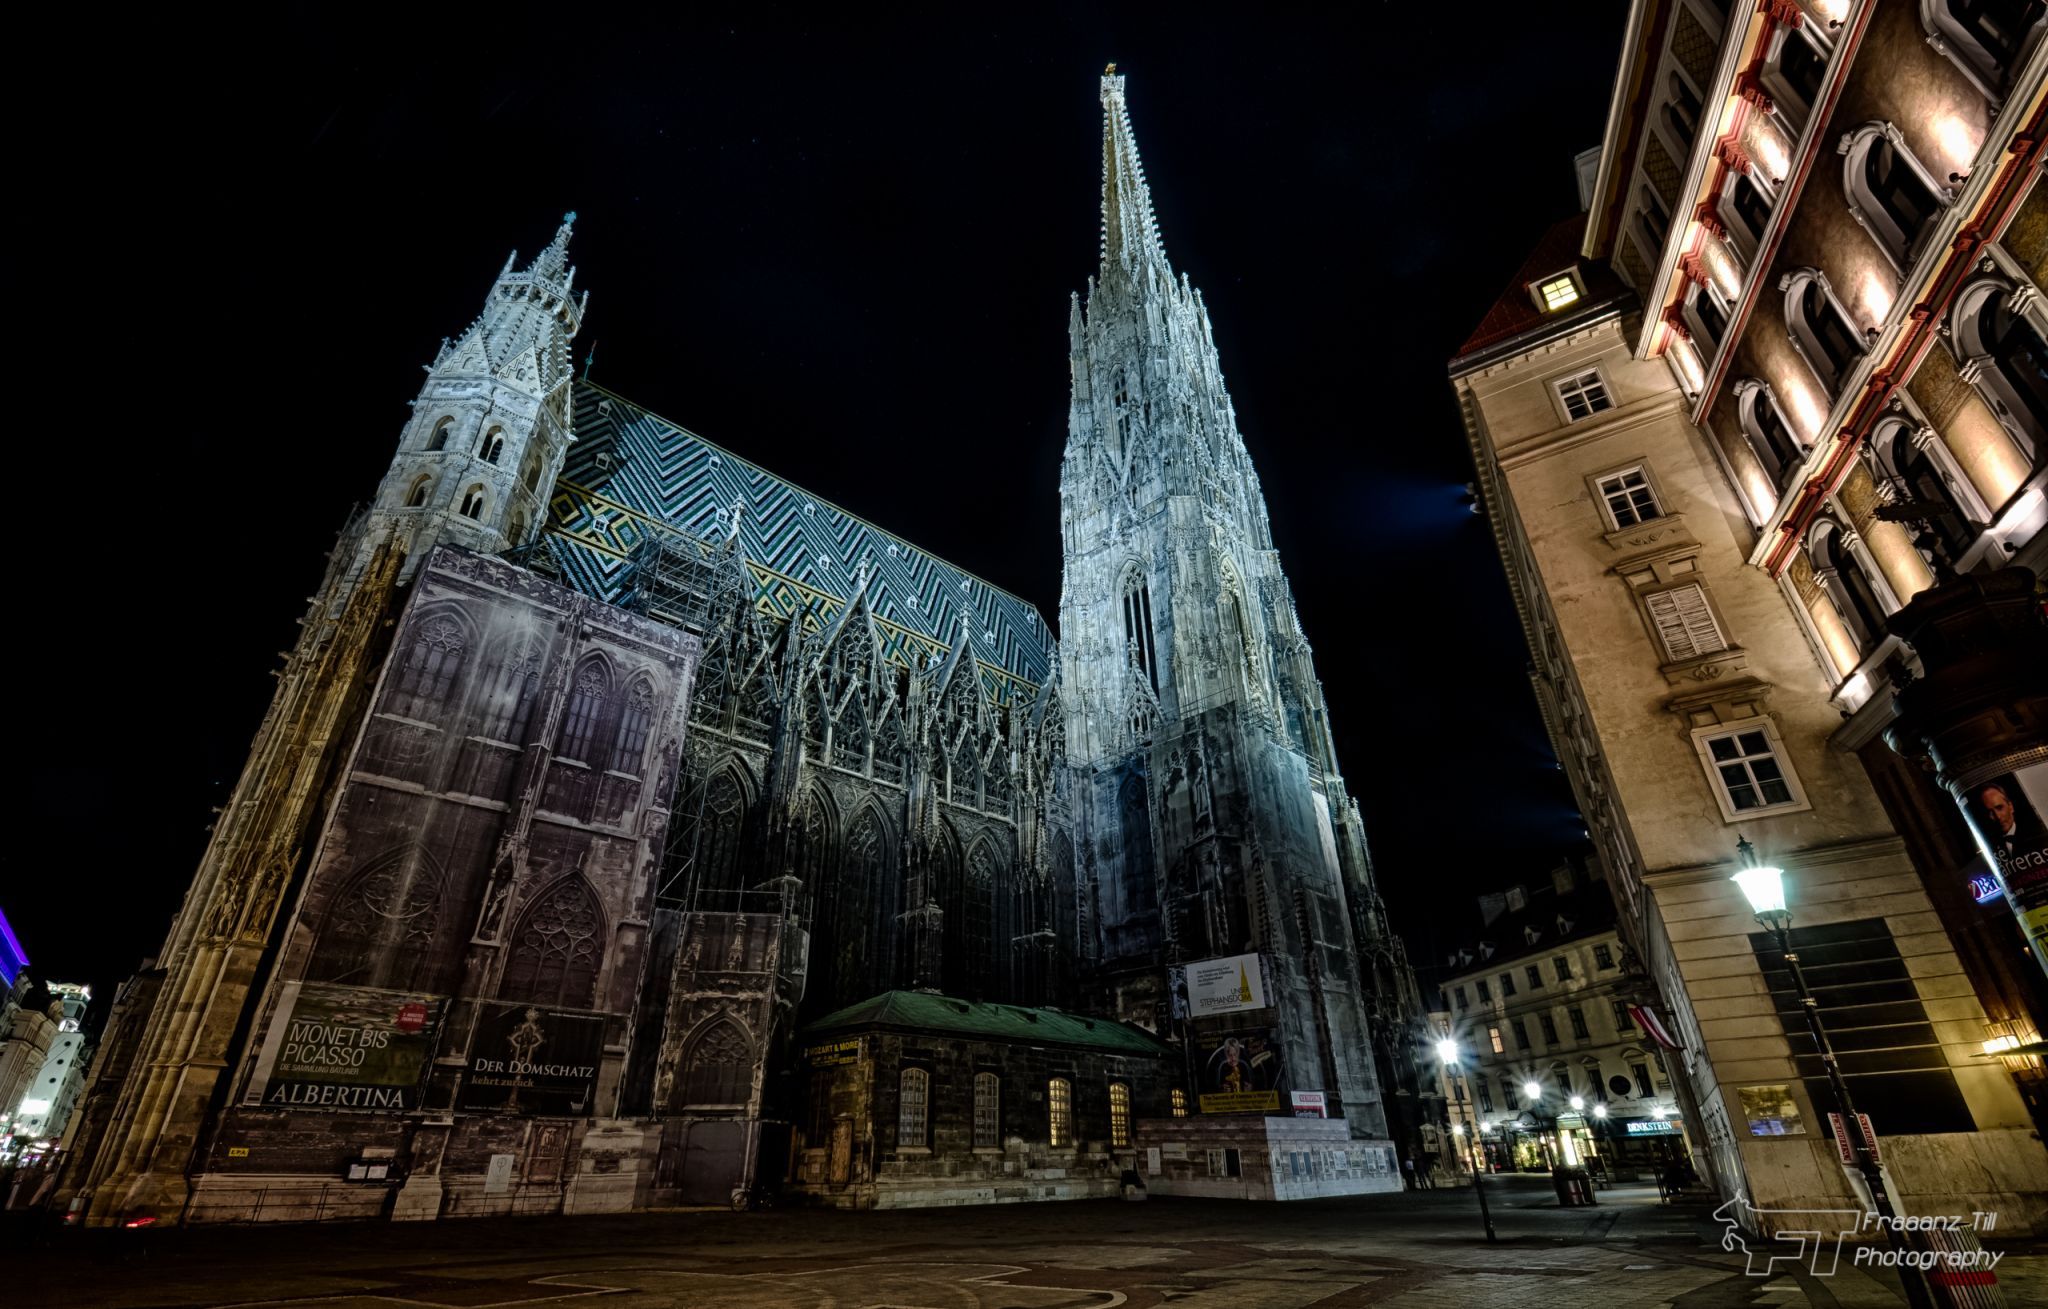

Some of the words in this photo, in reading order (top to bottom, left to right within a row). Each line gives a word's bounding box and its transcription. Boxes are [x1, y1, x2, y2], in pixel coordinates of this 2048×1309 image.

[289, 1023, 360, 1046] MONET
[359, 1029, 390, 1049] BIS
[282, 1043, 366, 1067] PICASSO
[475, 1058, 504, 1073] DER
[509, 1060, 595, 1078] DOMSCHATZ
[269, 1083, 405, 1109] ALBERTINA
